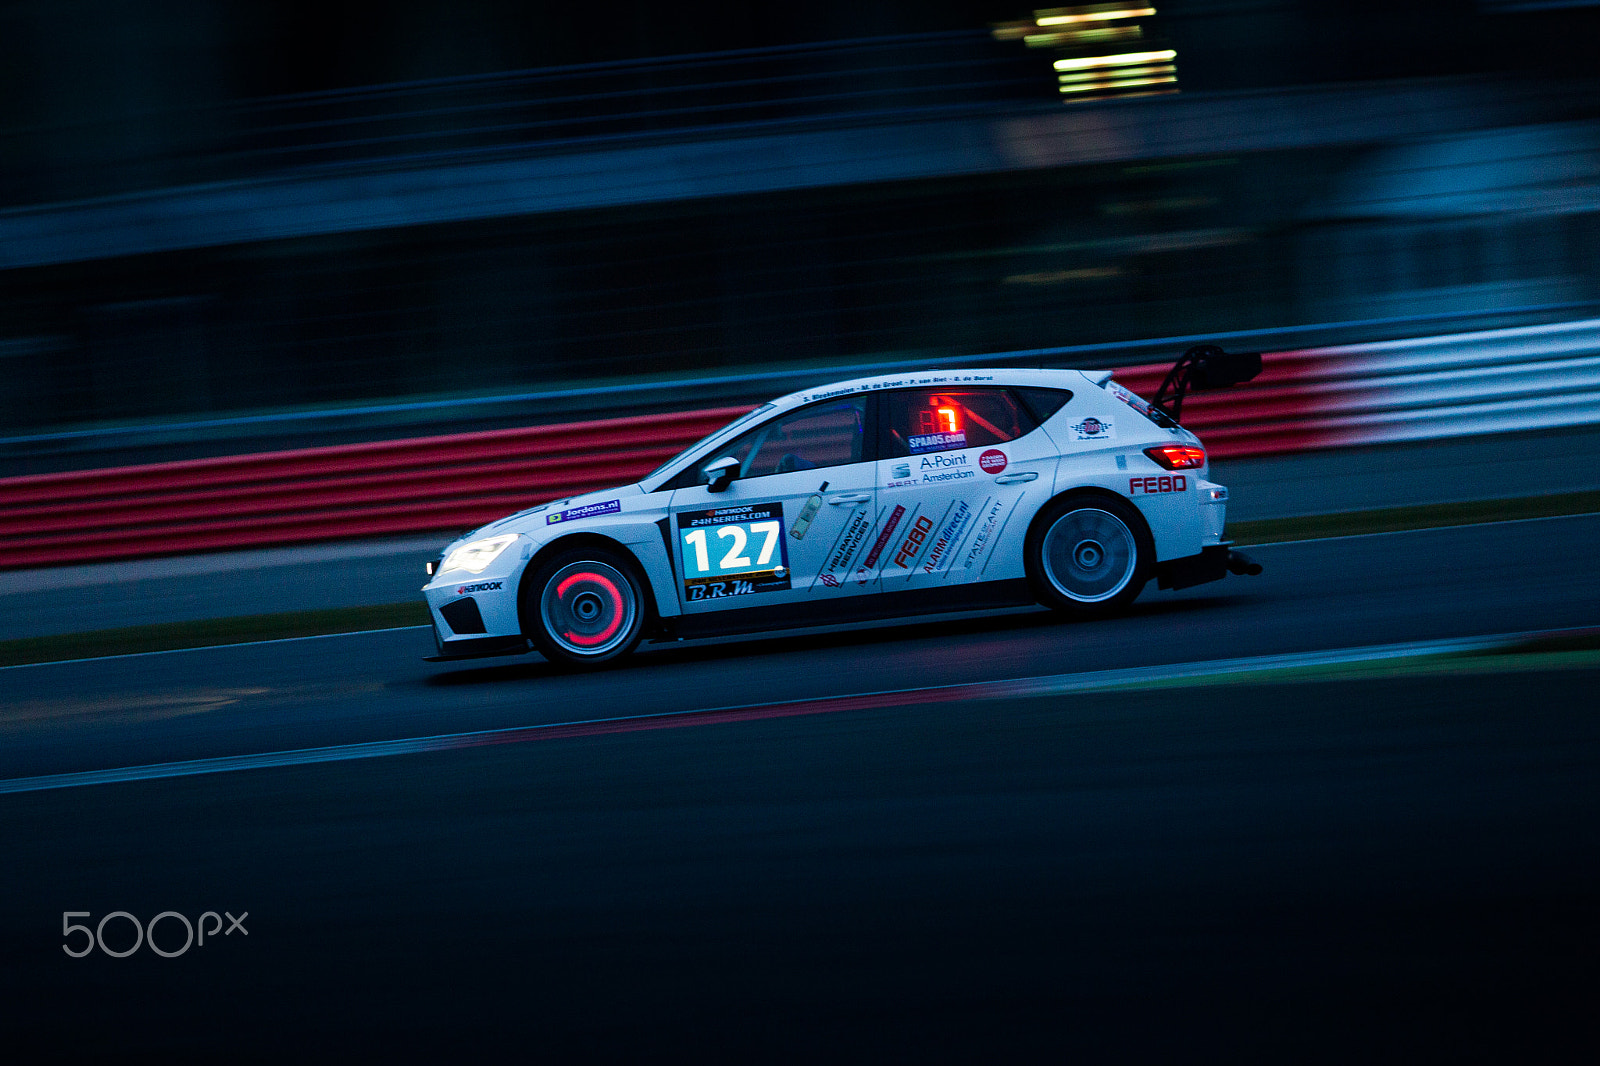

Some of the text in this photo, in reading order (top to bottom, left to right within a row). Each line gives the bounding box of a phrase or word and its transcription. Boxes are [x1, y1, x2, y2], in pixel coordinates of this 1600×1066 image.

[920, 454, 967, 470] A-Point
[922, 469, 975, 483] Amsterdam
[887, 479, 918, 488] SEAT
[566, 501, 619, 516] Jordans.nl
[839, 510, 867, 551] PAYROLL
[840, 521, 869, 568] SERVICES
[923, 500, 969, 574] ALARMdirect.nl
[684, 520, 780, 571] 127
